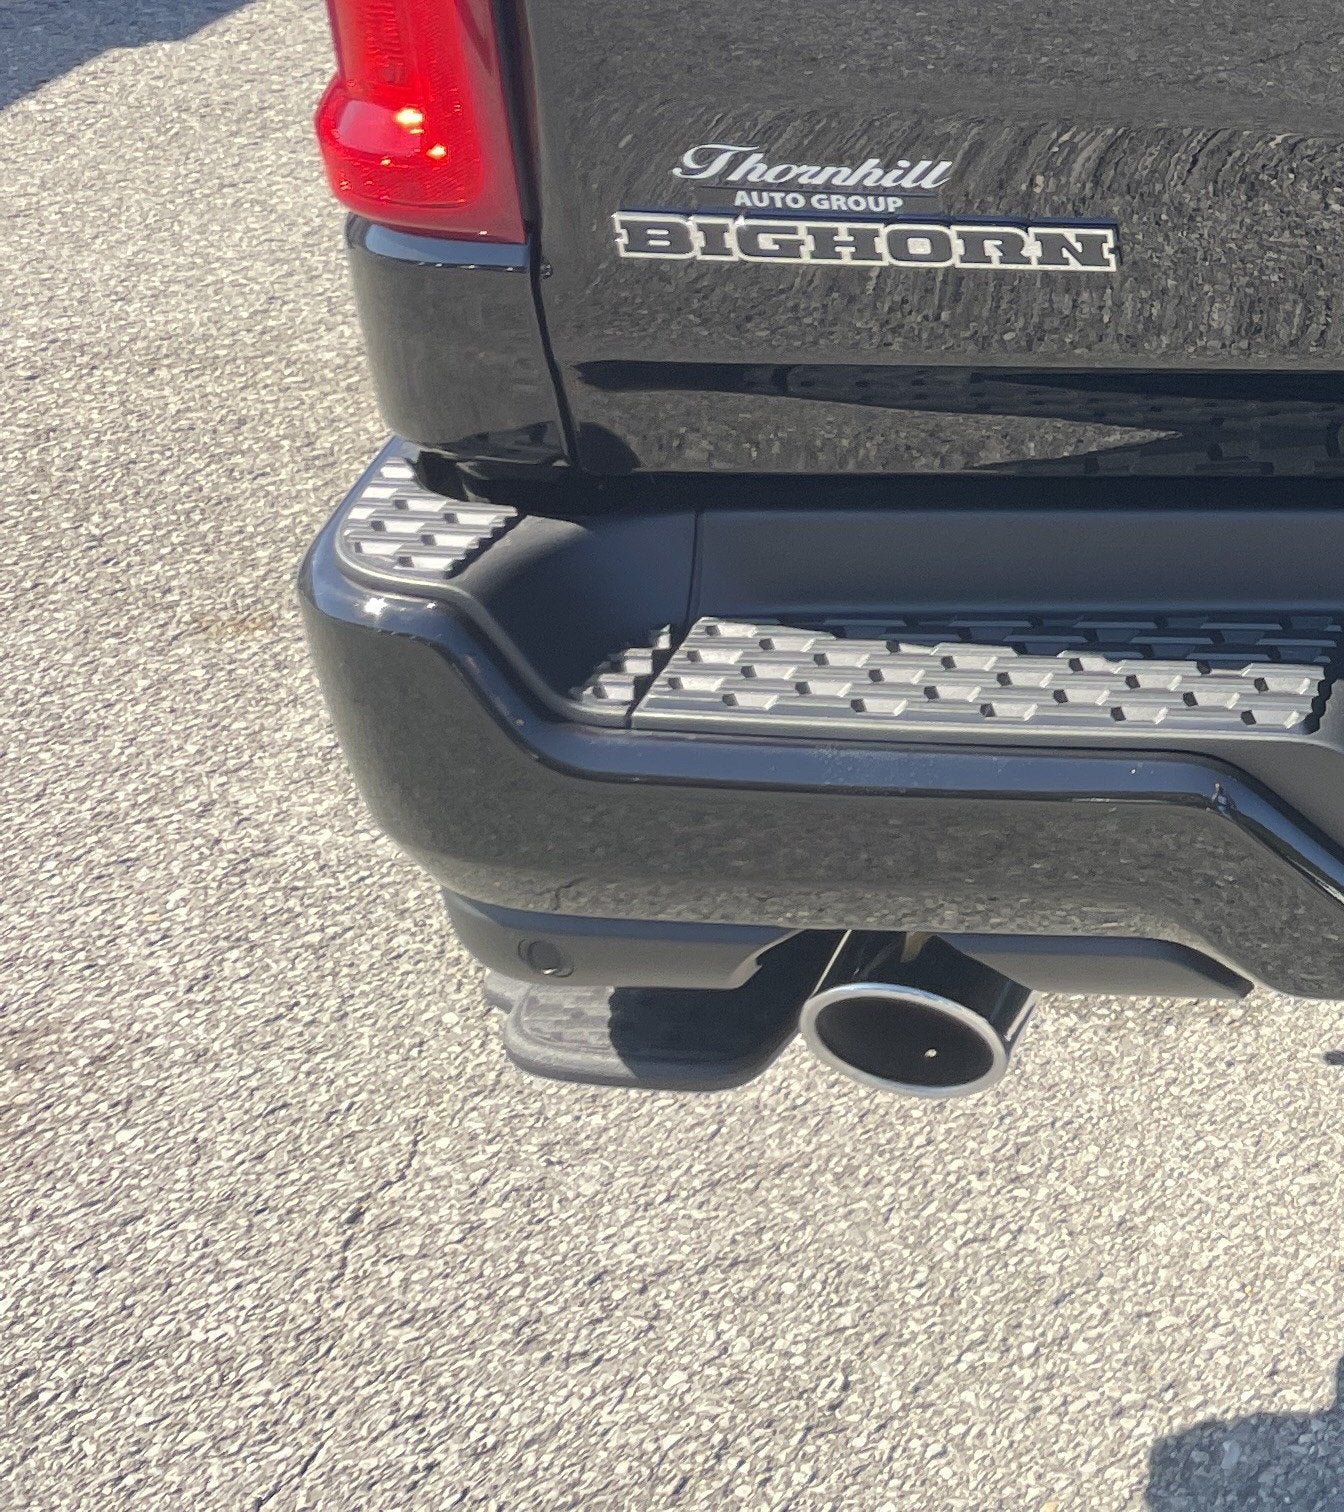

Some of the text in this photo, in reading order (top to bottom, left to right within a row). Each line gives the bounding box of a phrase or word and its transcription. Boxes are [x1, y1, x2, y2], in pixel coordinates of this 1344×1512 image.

[672, 143, 954, 189] Thornhill
[734, 190, 904, 213] AUTO GROUP
[612, 210, 1119, 272] BIGHORN
